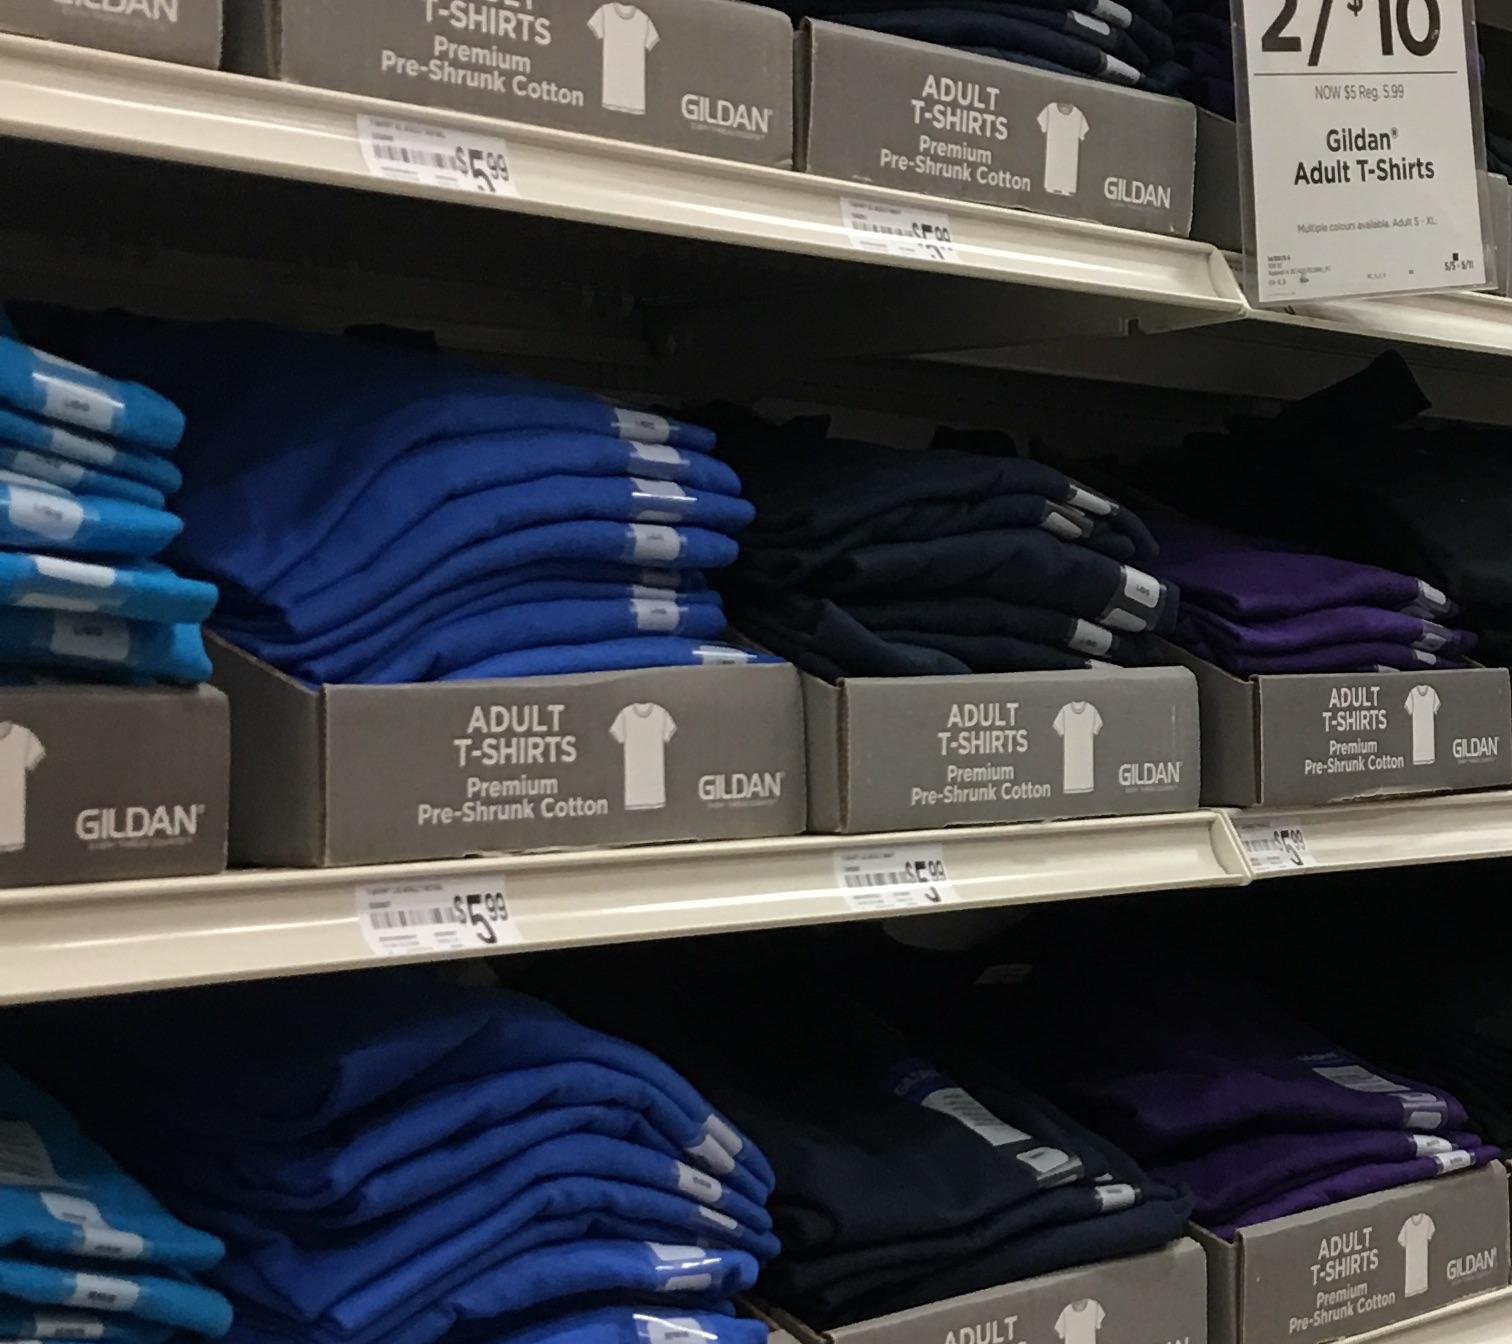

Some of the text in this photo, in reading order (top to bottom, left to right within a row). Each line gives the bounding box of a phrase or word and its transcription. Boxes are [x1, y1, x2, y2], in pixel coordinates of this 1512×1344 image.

[433, 34, 532, 74] Premium
[380, 50, 585, 108] Pre-Shrunk Cotton
[921, 74, 1000, 112] ADULT
[1315, 83, 1405, 103] NOW $5 Reg. 5.99
[680, 92, 774, 134] GILDAN
[911, 99, 1009, 141] T-SHIRTS
[919, 134, 993, 165] Premium
[879, 148, 1032, 193] Pre-Shrunk Cotton
[1293, 156, 1436, 186] Adult T-Shirts
[1103, 176, 1172, 210] GILDAN
[1297, 222, 1328, 235] Multiple
[1392, 217, 1413, 228] Adult
[1328, 685, 1381, 710] ADULT
[466, 703, 566, 736] ADULT
[947, 702, 1020, 729] ADULT
[1321, 708, 1389, 734] T-SHIRTS
[453, 735, 578, 769] T-SHIRTS
[937, 729, 1029, 756] T-SHIRTS
[1452, 735, 1500, 758] GILDAN
[466, 774, 559, 800] Premium
[697, 771, 785, 804] GILDAN
[946, 762, 1015, 784] Premium
[1118, 761, 1183, 787] GILDAN
[911, 781, 1052, 806] Pre-Shrunk Cotton
[75, 803, 206, 842] GILDAN
[417, 794, 609, 827] Pre-Shrunk Cotton
[1317, 1226, 1374, 1261] ADULT
[1310, 1249, 1380, 1287] T-SHIRTS
[1446, 1247, 1498, 1282] GILDAN
[1316, 1279, 1369, 1310] Premium
[1288, 1289, 1397, 1335] Pre-Shrunk Cotton
